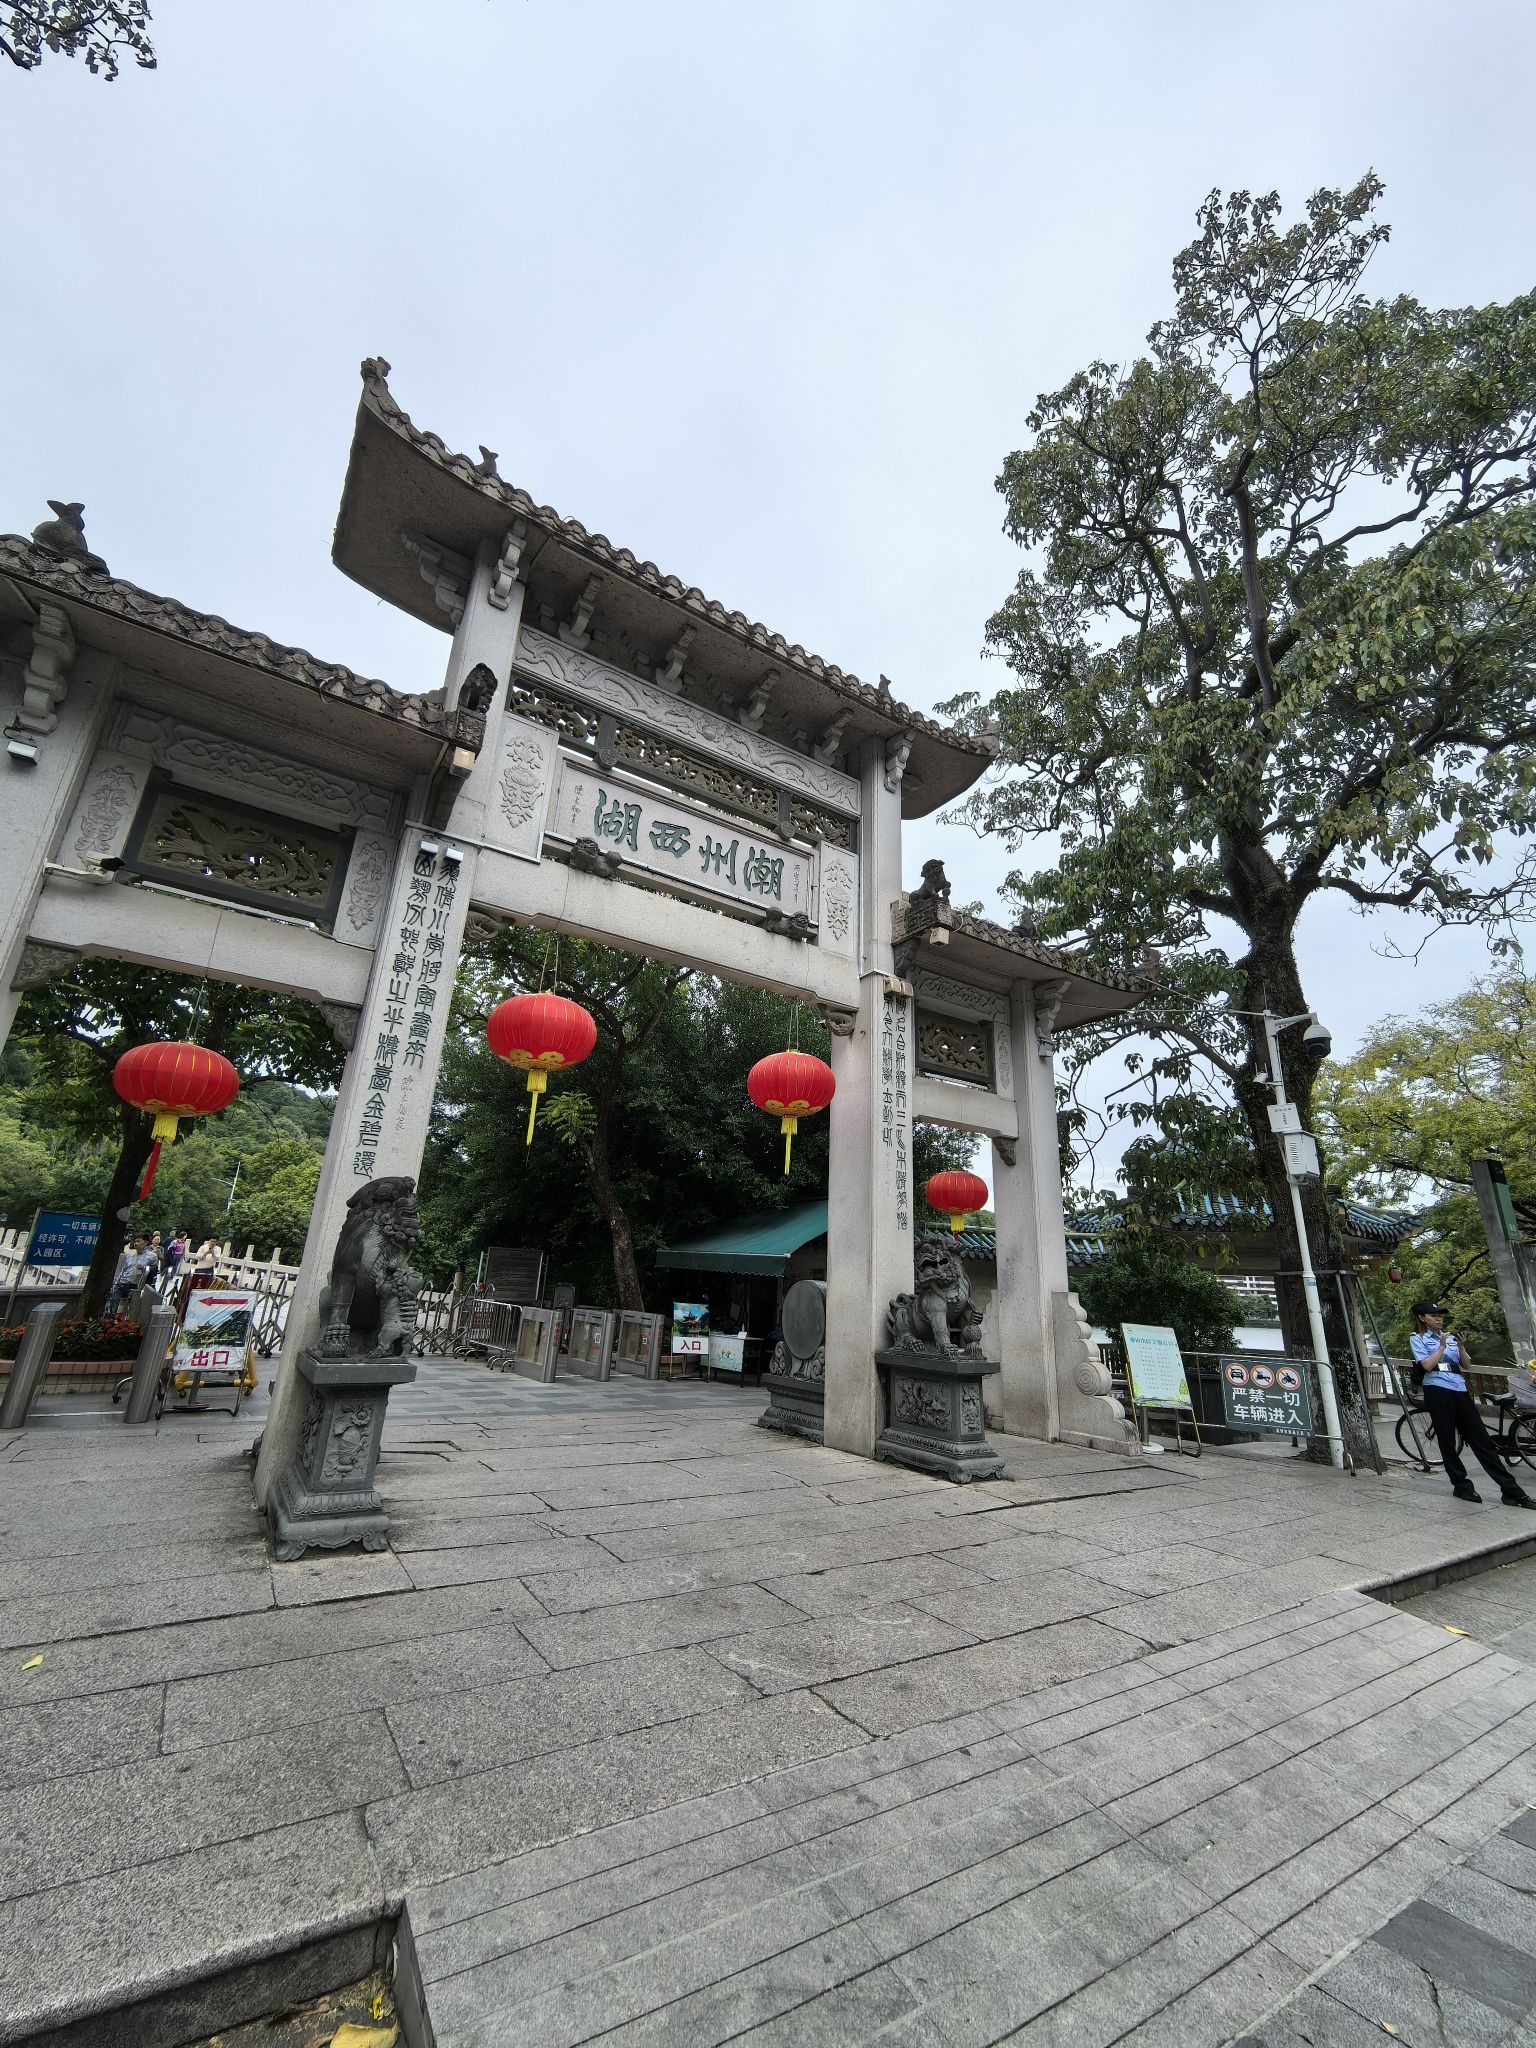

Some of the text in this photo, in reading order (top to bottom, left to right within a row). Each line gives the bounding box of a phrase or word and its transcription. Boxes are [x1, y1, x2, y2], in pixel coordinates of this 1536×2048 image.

[593, 788, 785, 901] 潮州西湖
[680, 1340, 701, 1351] 入口
[190, 1350, 230, 1367] 出口
[1232, 1387, 1300, 1407] 严禁一切
[1233, 1403, 1304, 1426] 车辆进入
